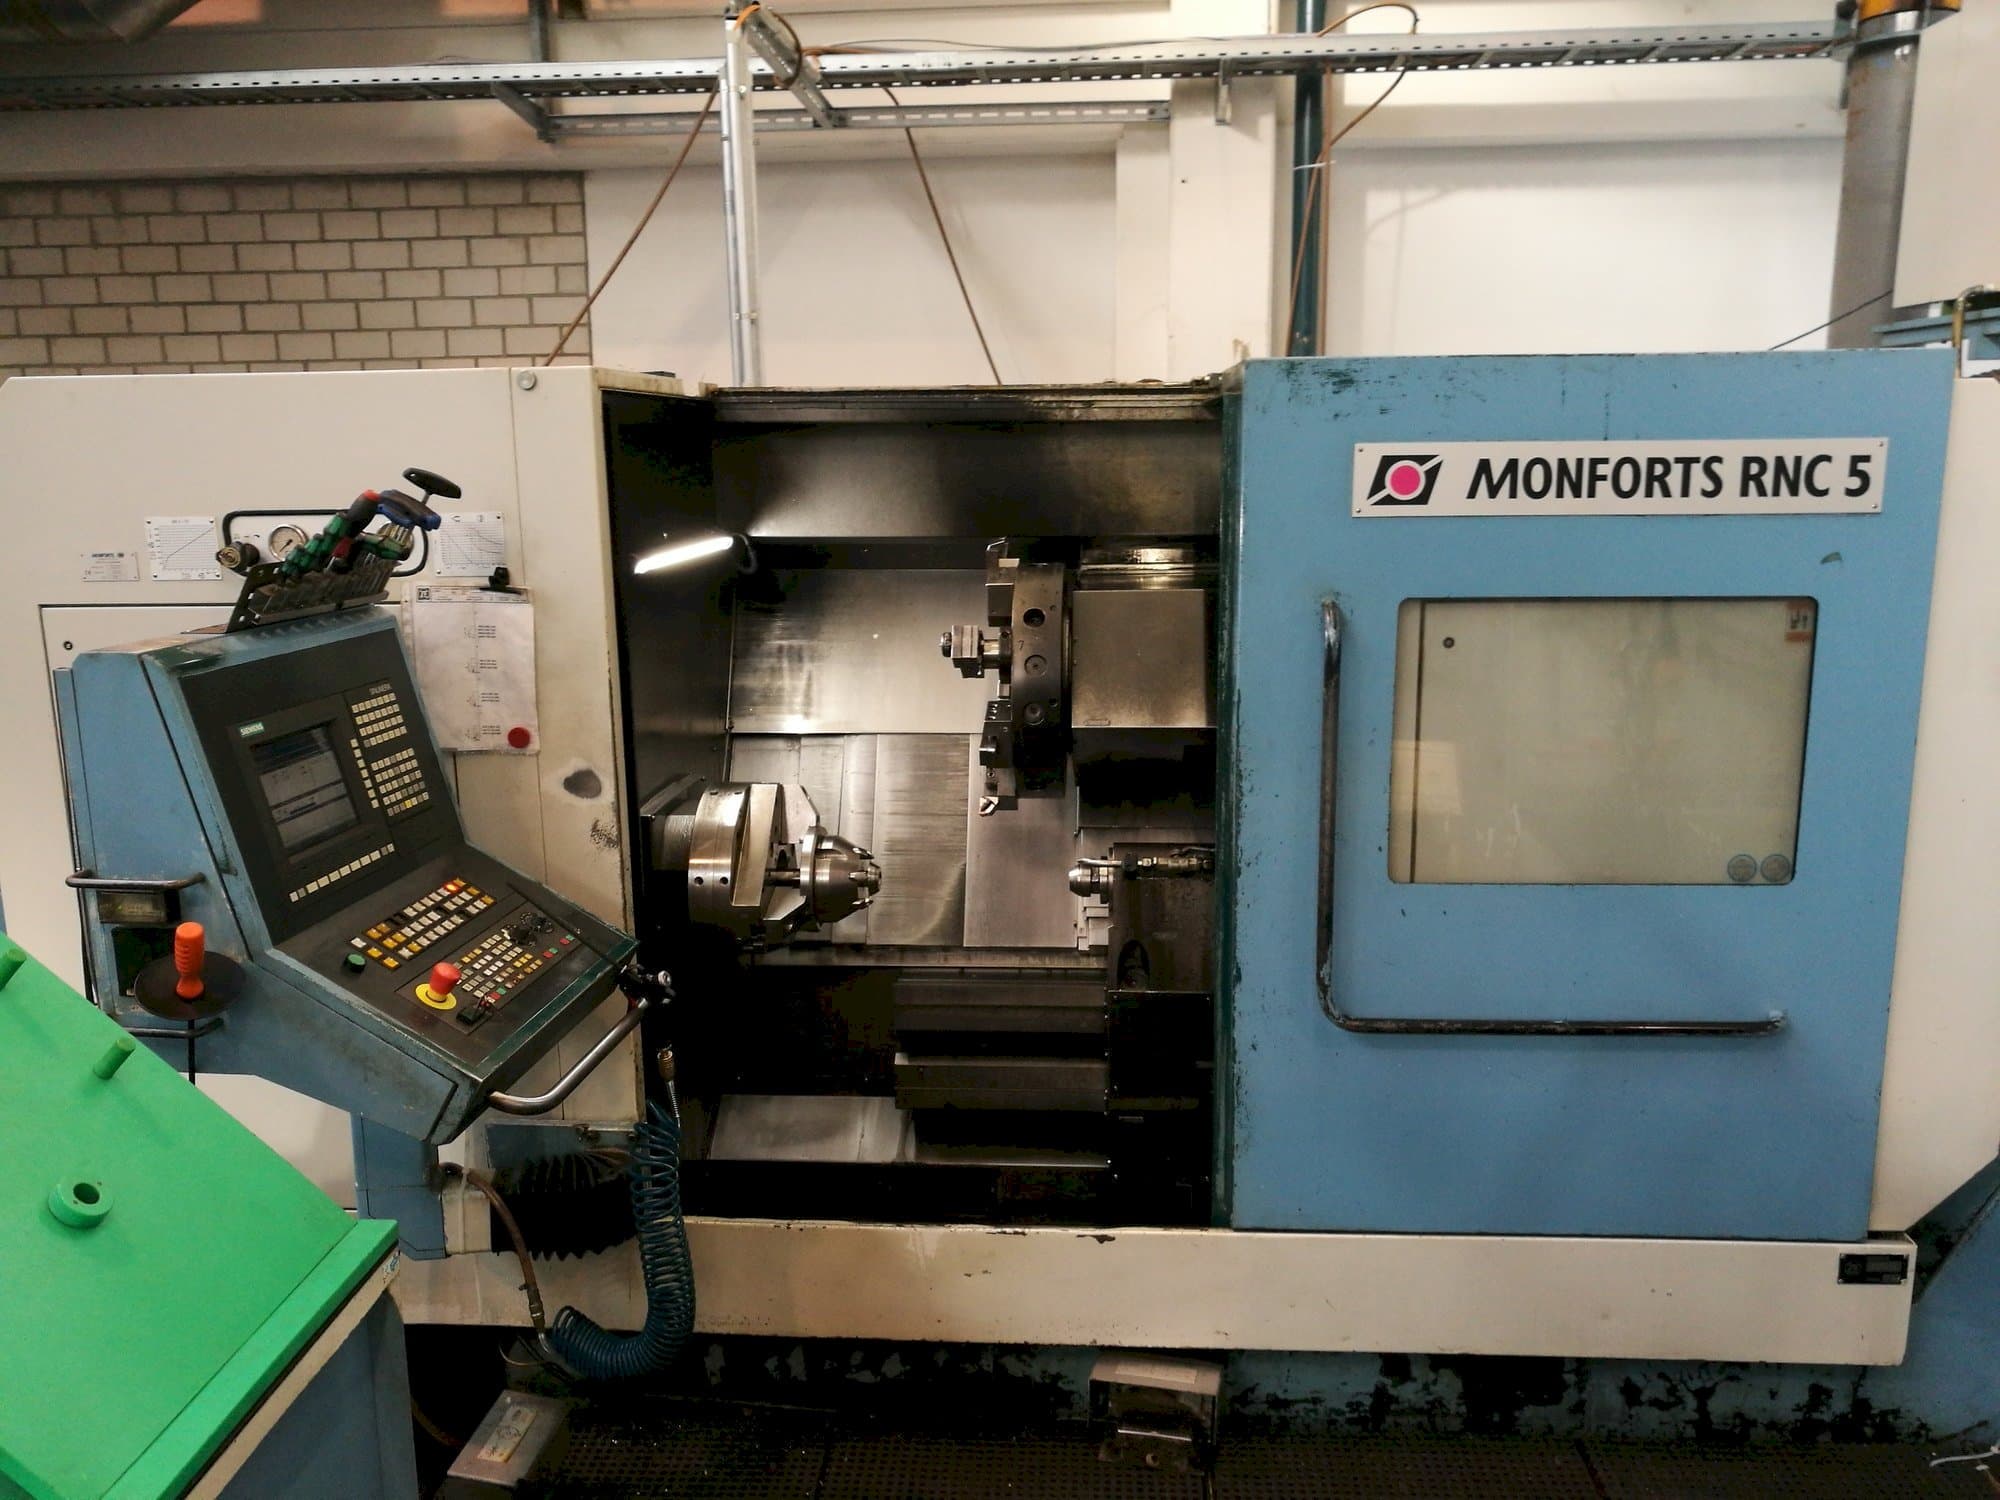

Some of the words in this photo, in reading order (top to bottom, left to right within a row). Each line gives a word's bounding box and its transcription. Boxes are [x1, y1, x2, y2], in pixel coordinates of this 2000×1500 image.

[1466, 457, 1724, 499] MONFORTS
[1740, 454, 1832, 498] RNC
[1844, 454, 1872, 498] 5
